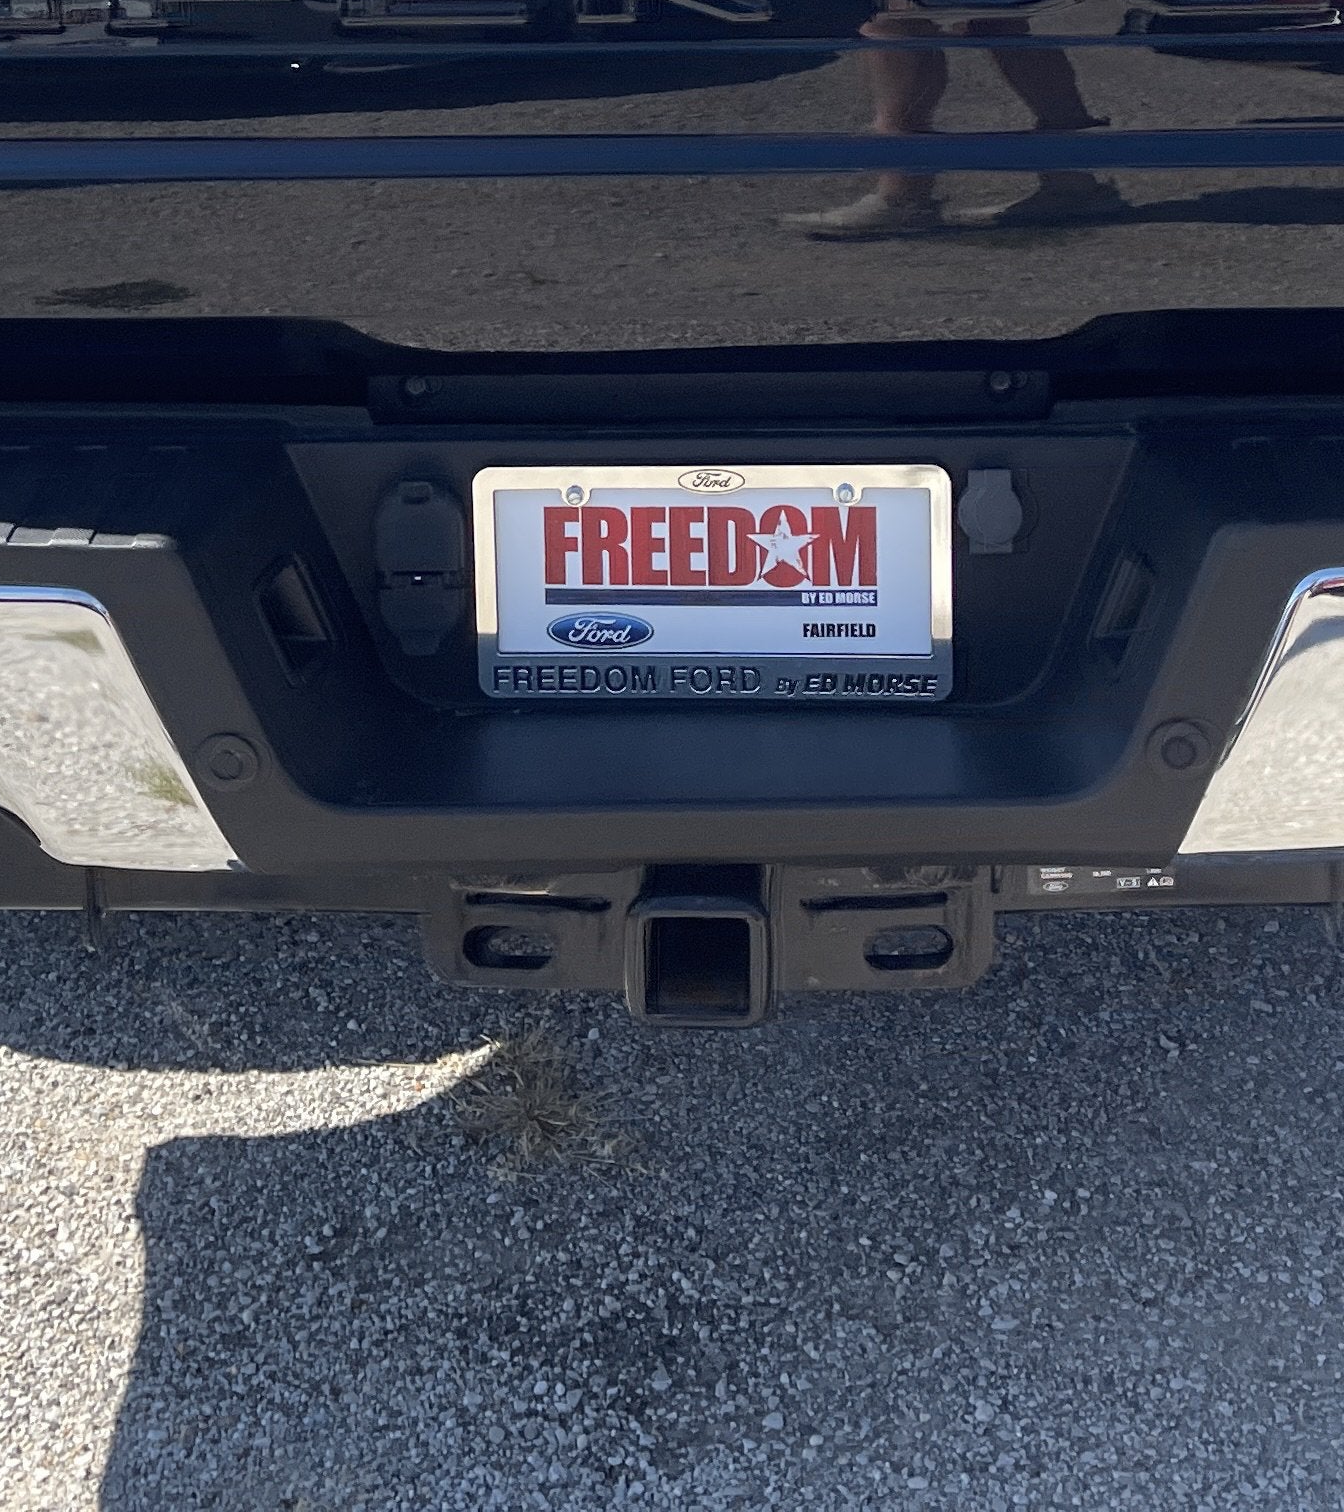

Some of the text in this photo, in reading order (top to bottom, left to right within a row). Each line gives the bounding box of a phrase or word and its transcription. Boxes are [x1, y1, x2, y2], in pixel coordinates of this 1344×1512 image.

[691, 471, 733, 491] Ford
[543, 504, 878, 588] FREEDOM
[801, 591, 877, 605] BY ED MORSE
[568, 615, 632, 644] Ford
[802, 622, 877, 639] FAIRFIELD
[492, 665, 939, 697] FREEDOM FORD By ED MORSE
